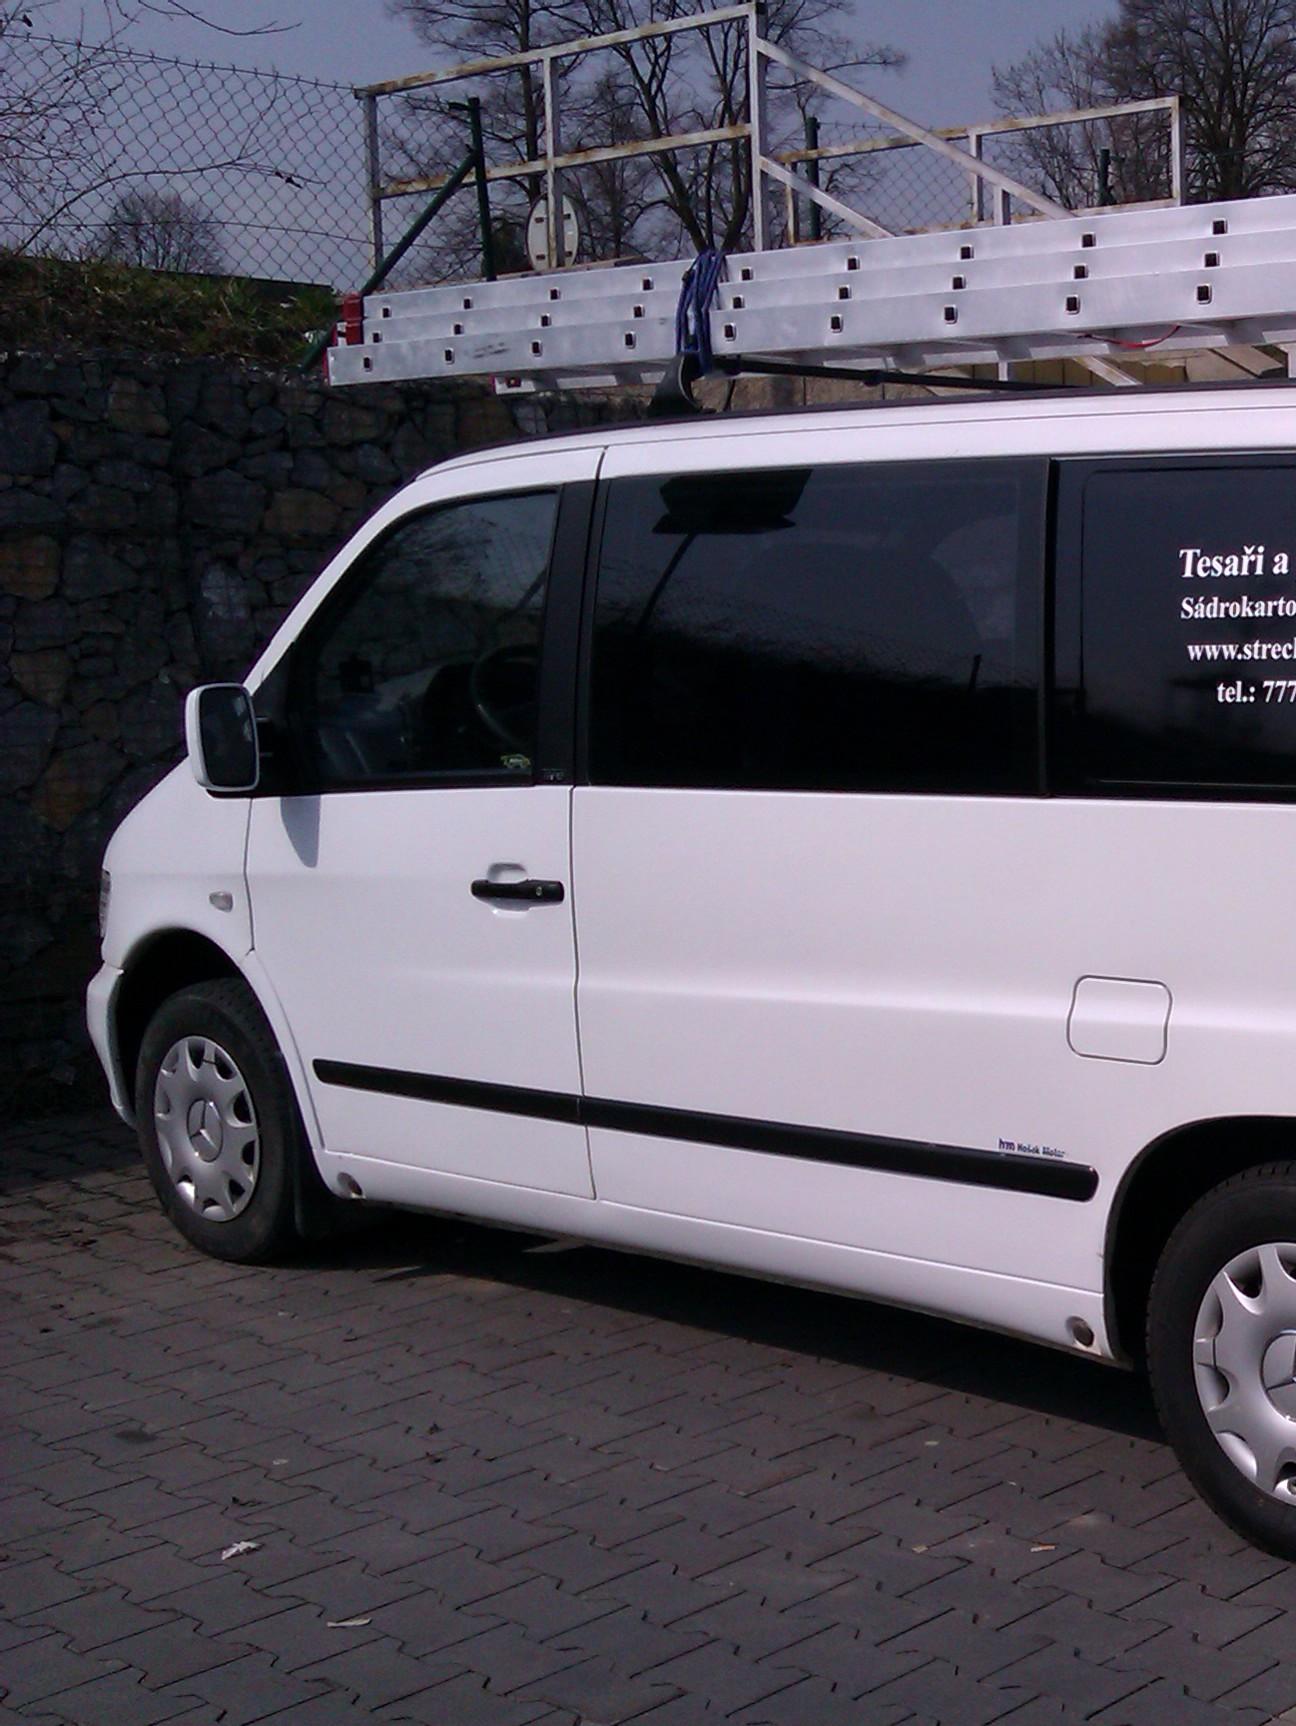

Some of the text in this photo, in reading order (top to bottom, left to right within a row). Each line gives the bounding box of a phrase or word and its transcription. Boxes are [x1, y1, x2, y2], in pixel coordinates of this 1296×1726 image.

[1179, 545, 1264, 578] Tesaři
[1272, 553, 1289, 575] a
[1217, 680, 1255, 704] tel.:
